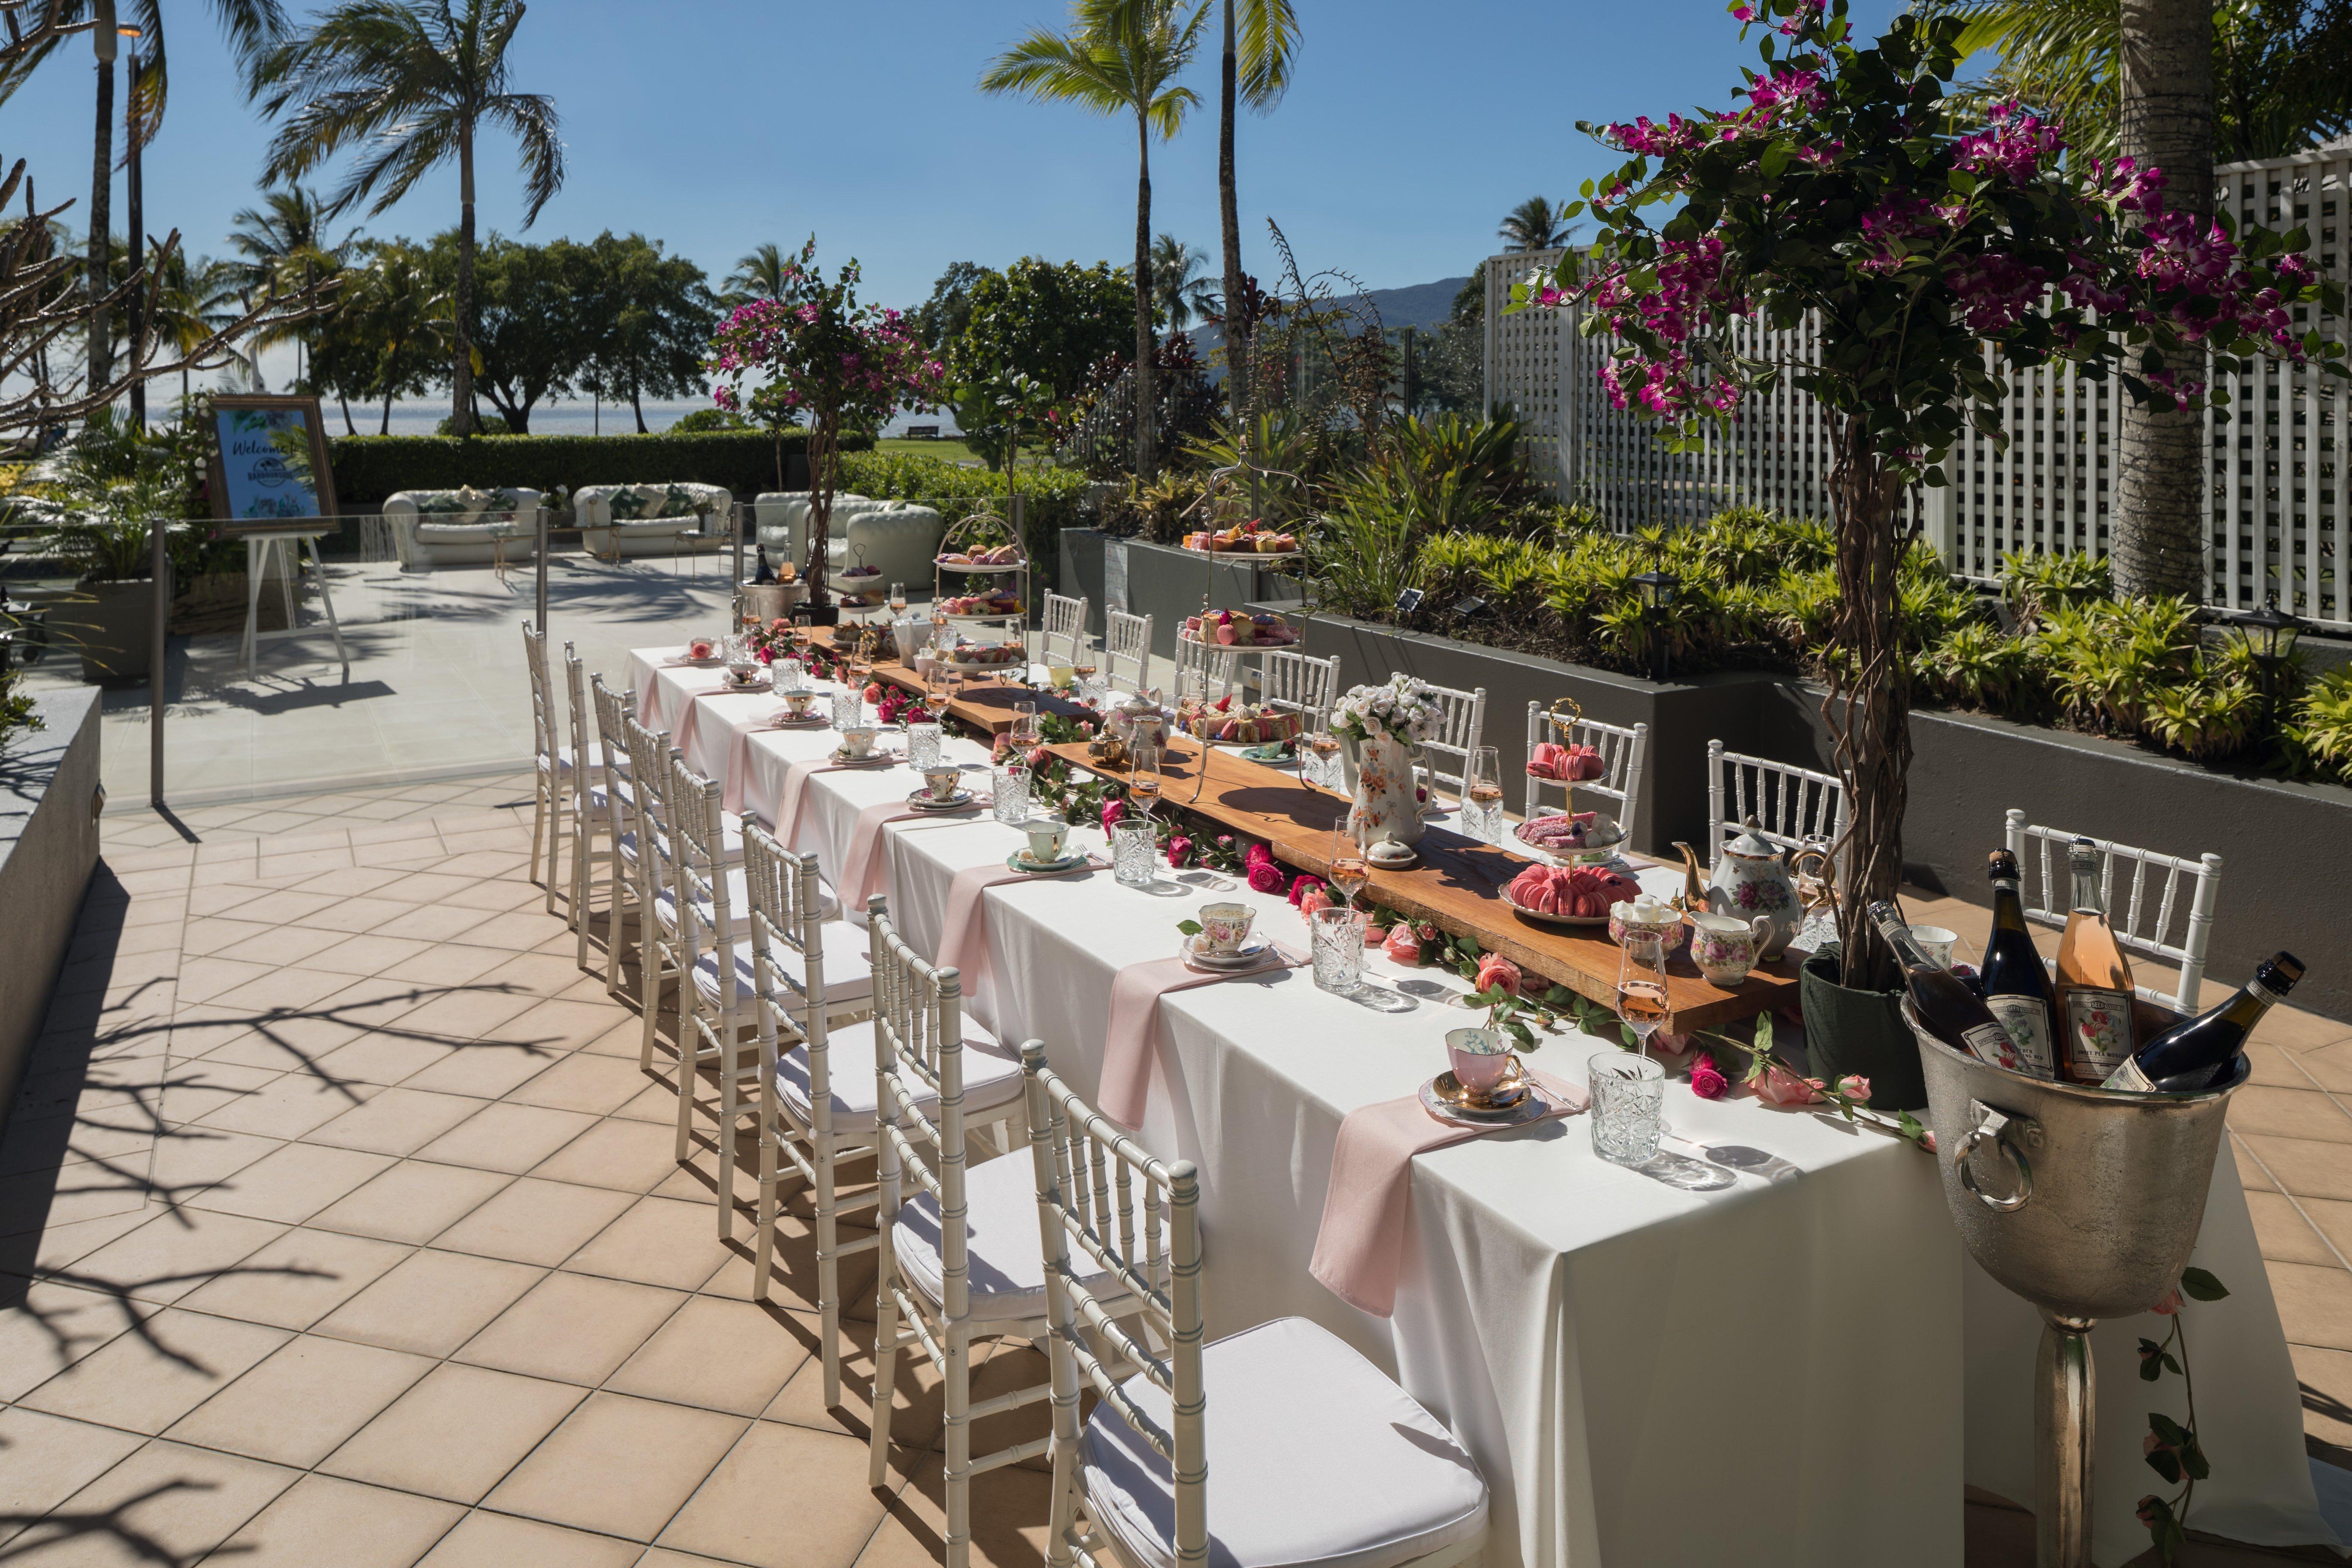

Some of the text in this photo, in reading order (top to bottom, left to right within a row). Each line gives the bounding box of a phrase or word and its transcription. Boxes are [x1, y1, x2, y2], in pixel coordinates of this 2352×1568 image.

[233, 440, 285, 456] Welcome
[1881, 923, 1894, 935] SPRING
[2251, 983, 2265, 996] SEED
[1978, 1035, 1994, 1046] SPRING
